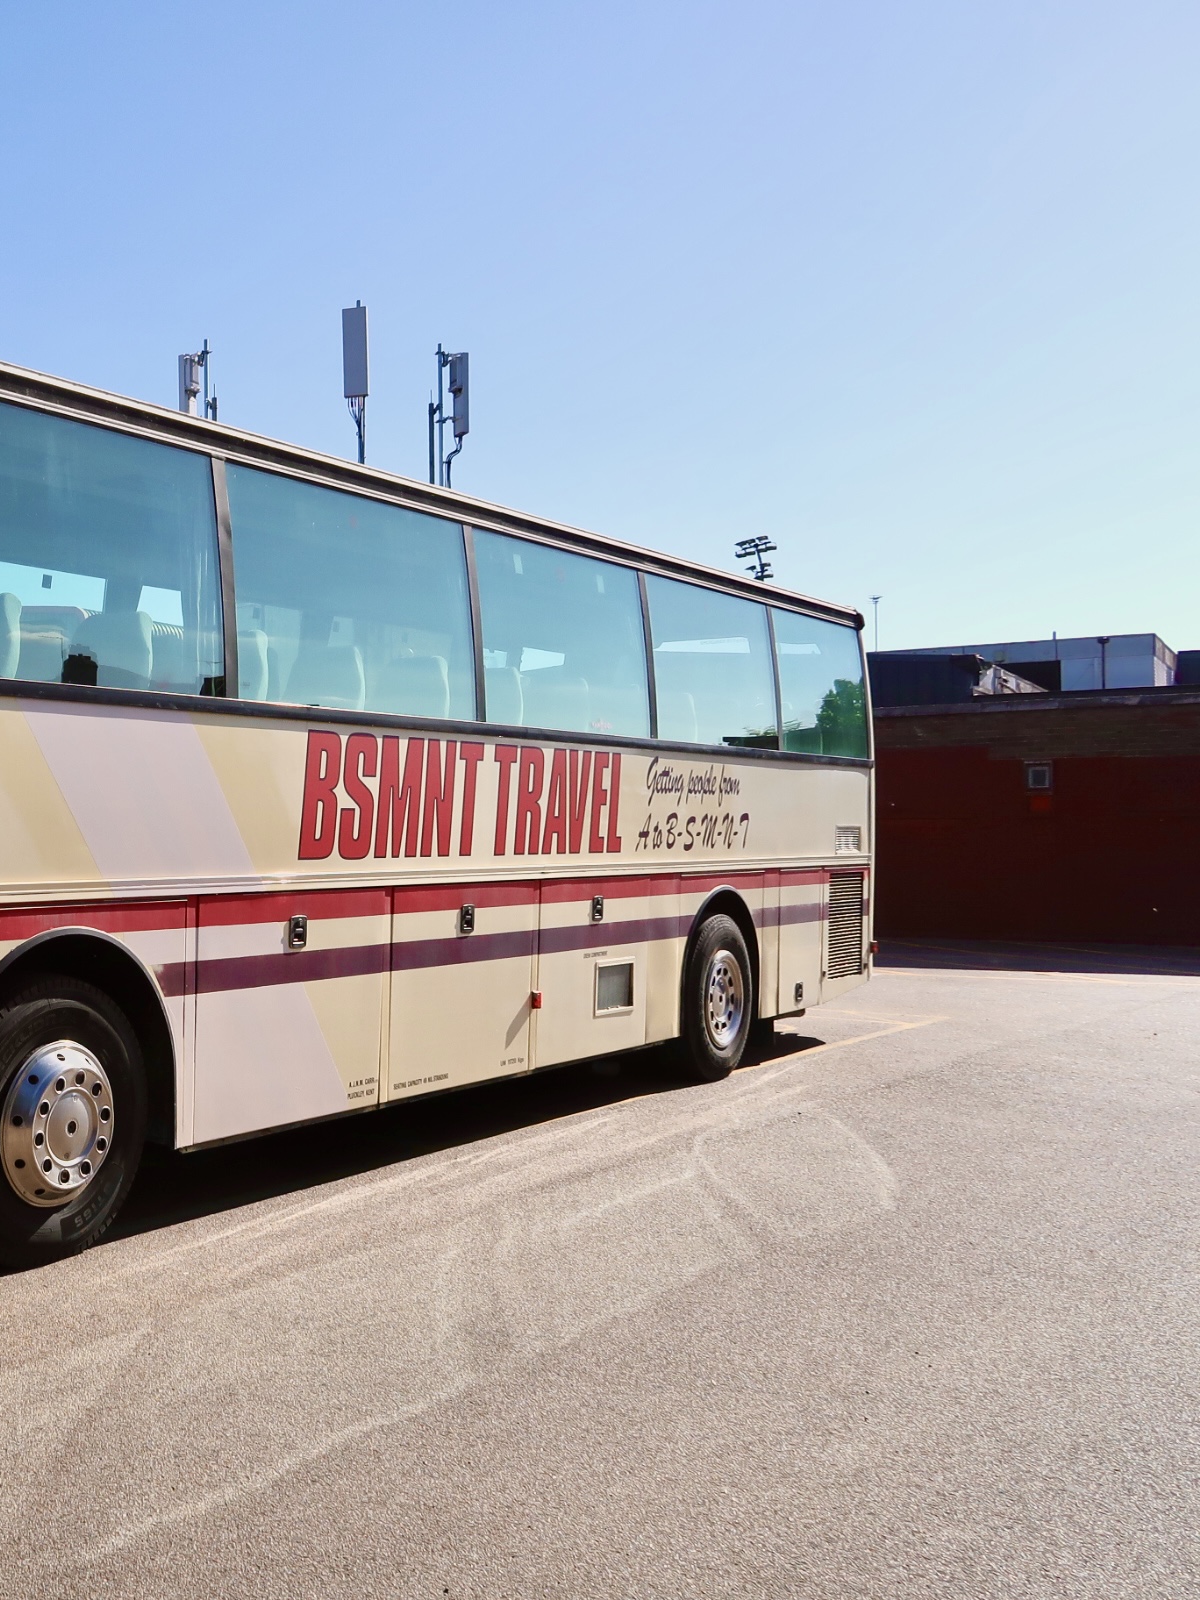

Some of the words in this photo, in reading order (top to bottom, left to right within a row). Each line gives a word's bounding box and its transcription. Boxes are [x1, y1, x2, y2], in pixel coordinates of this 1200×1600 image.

[298, 729, 484, 860] BSMNT
[493, 745, 622, 857] TRAVEL
[646, 755, 684, 807] Getting
[685, 764, 717, 805] people
[717, 764, 740, 807] from
[635, 812, 652, 852] A
